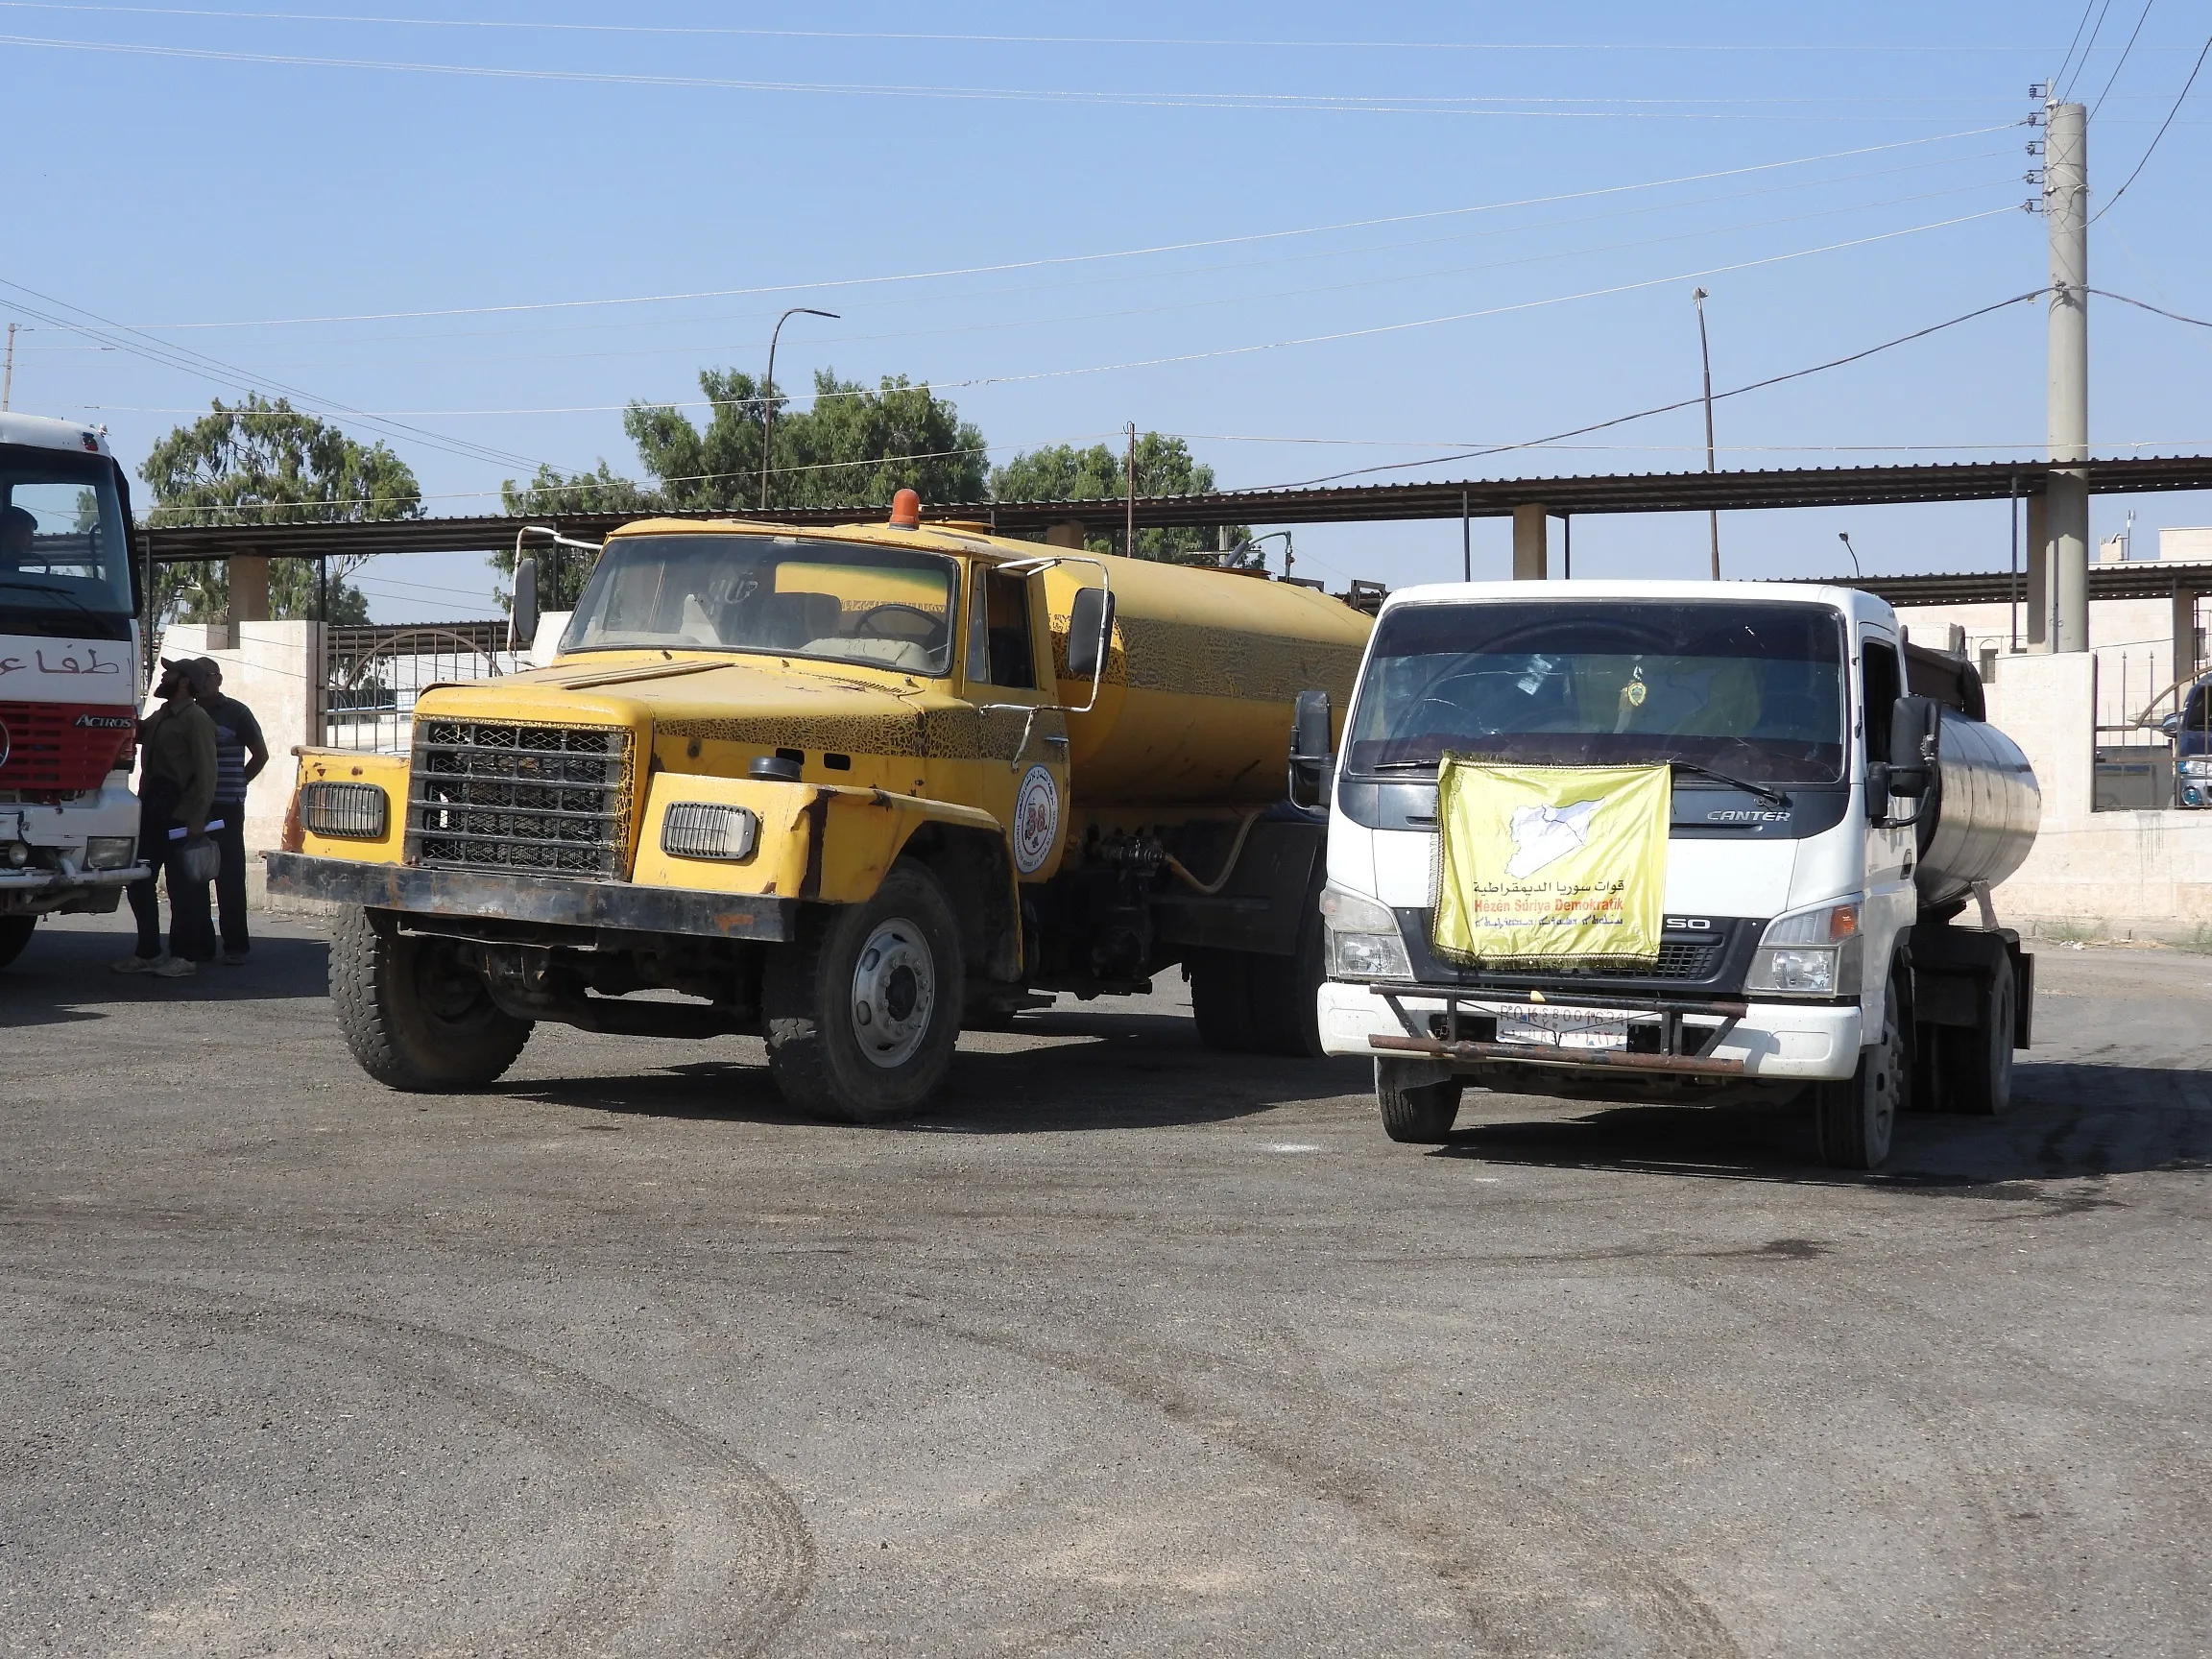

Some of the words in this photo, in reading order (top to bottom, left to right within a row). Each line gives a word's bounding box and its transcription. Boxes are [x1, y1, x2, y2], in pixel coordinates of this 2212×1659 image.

[1707, 810, 1791, 822] CANTER
[1474, 880, 1551, 897] الديمقراطية
[1557, 880, 1591, 896] سوريا
[1594, 880, 1624, 895] قوات
[1475, 899, 1510, 912] Hêzên
[1554, 898, 1623, 911] Demokratîk
